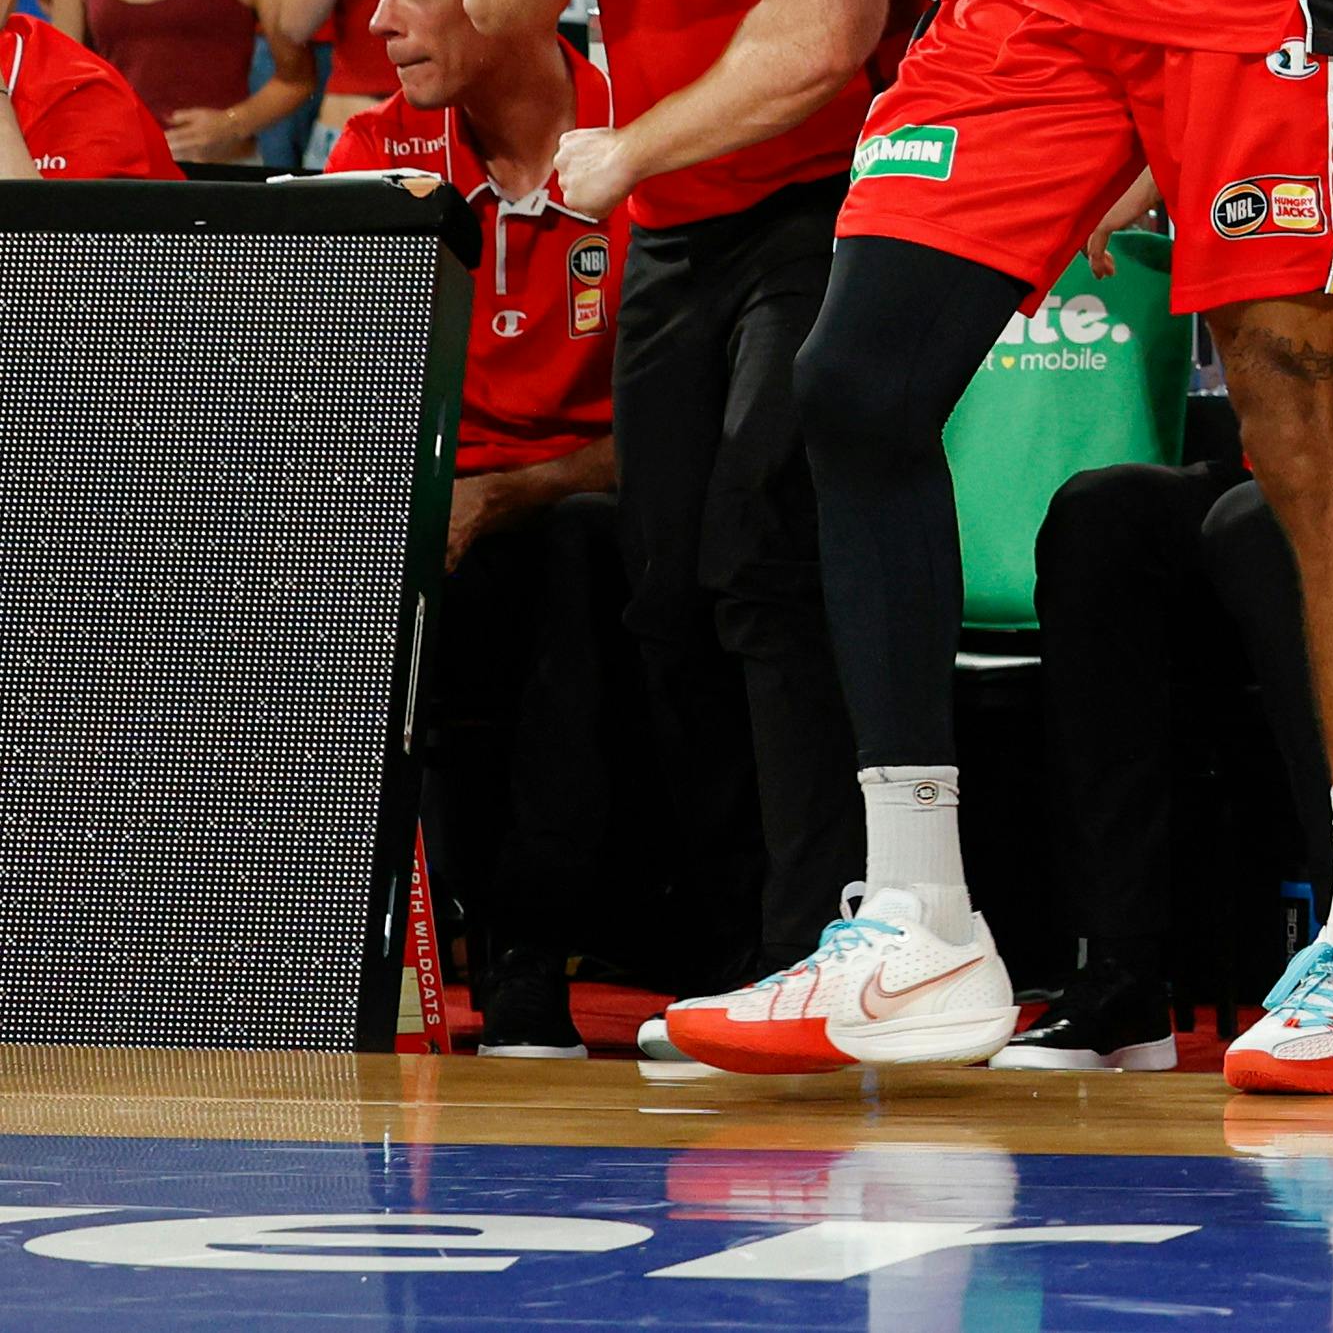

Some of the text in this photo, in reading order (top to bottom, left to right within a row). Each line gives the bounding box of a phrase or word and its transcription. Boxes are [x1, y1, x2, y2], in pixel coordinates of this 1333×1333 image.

[1225, 196, 1256, 224] NBL
[1274, 196, 1314, 209] HUNGRY
[1020, 348, 1107, 371] mobile
[413, 920, 441, 1025] WILDCATS
